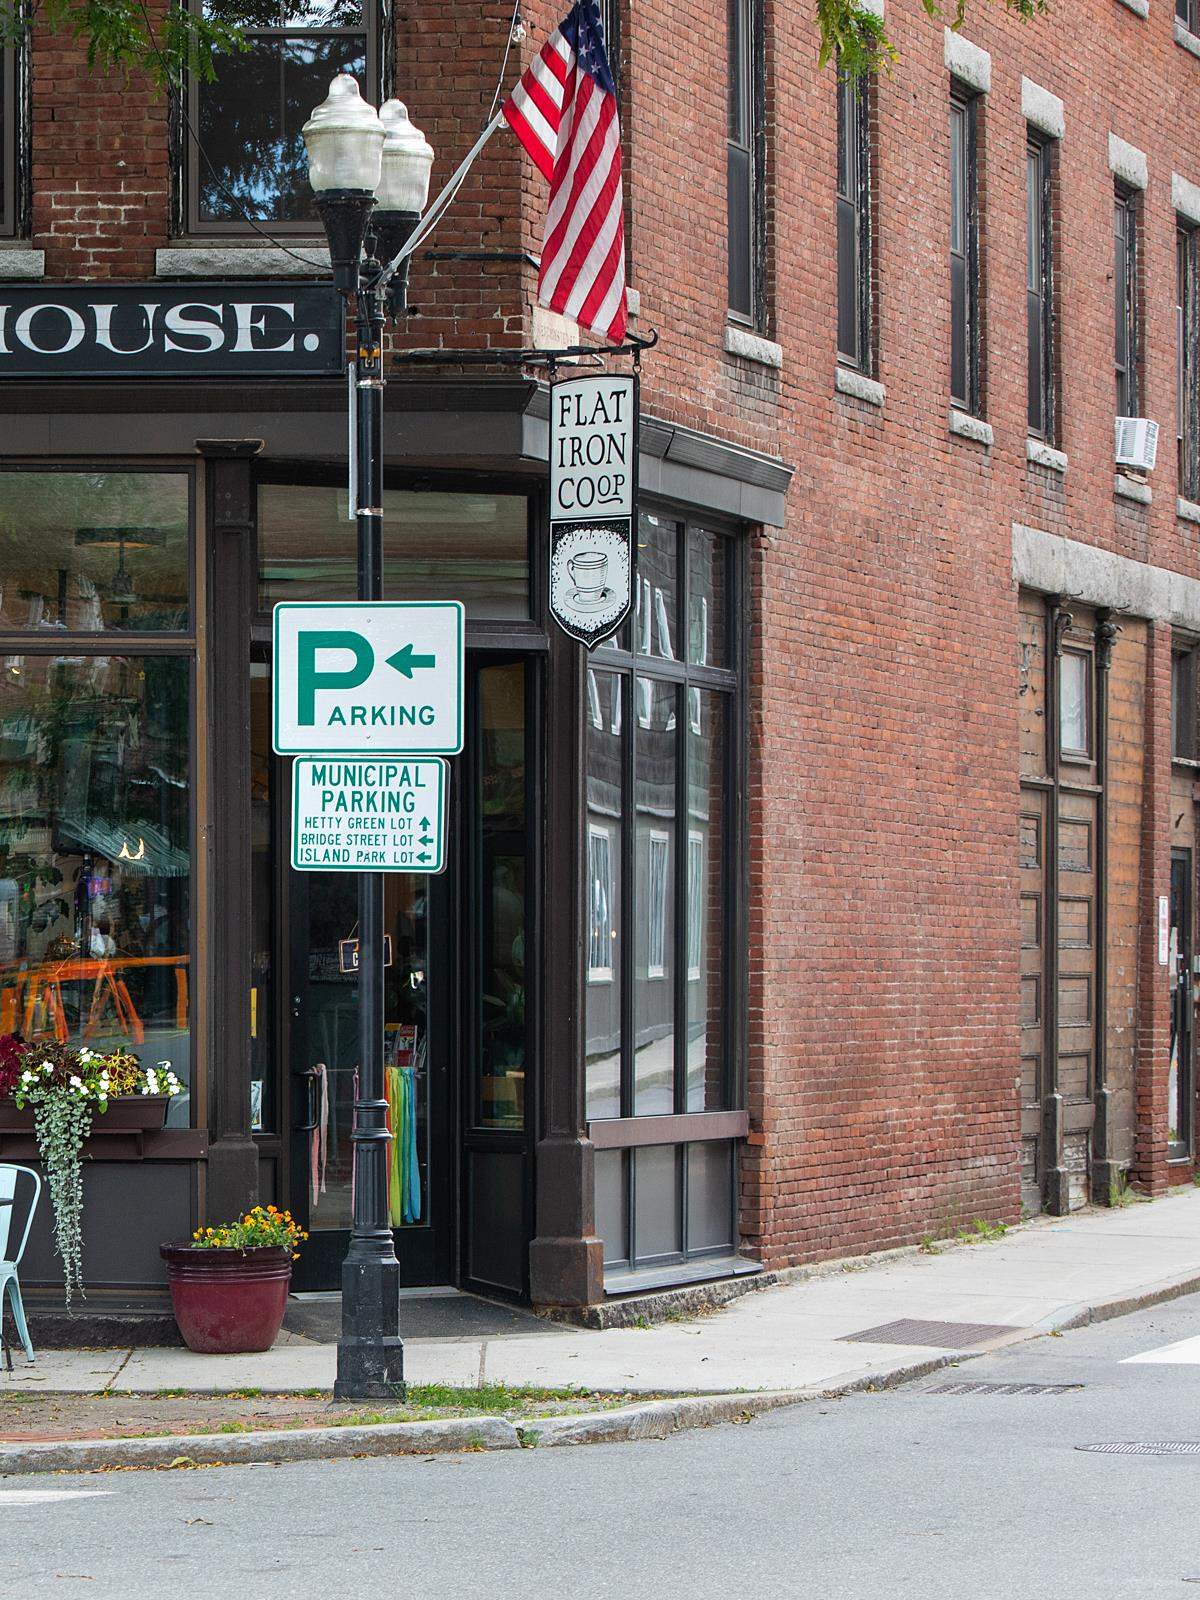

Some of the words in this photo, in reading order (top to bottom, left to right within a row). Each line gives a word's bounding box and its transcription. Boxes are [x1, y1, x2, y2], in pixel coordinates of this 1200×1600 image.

[559, 390, 627, 427] FLAT
[558, 432, 626, 468] IRON
[558, 474, 625, 509] COOP
[311, 765, 426, 787] MUNICIPAL
[321, 790, 415, 813] PARKING
[304, 816, 342, 829] HETTY
[347, 816, 385, 829] GREEN
[391, 817, 412, 830] LOT
[301, 833, 341, 846] BRIDGE
[346, 833, 387, 846] STREET
[393, 834, 414, 847] LOT
[300, 848, 350, 863] ISLAND
[356, 851, 386, 863] PARK
[394, 851, 414, 863] LOT
